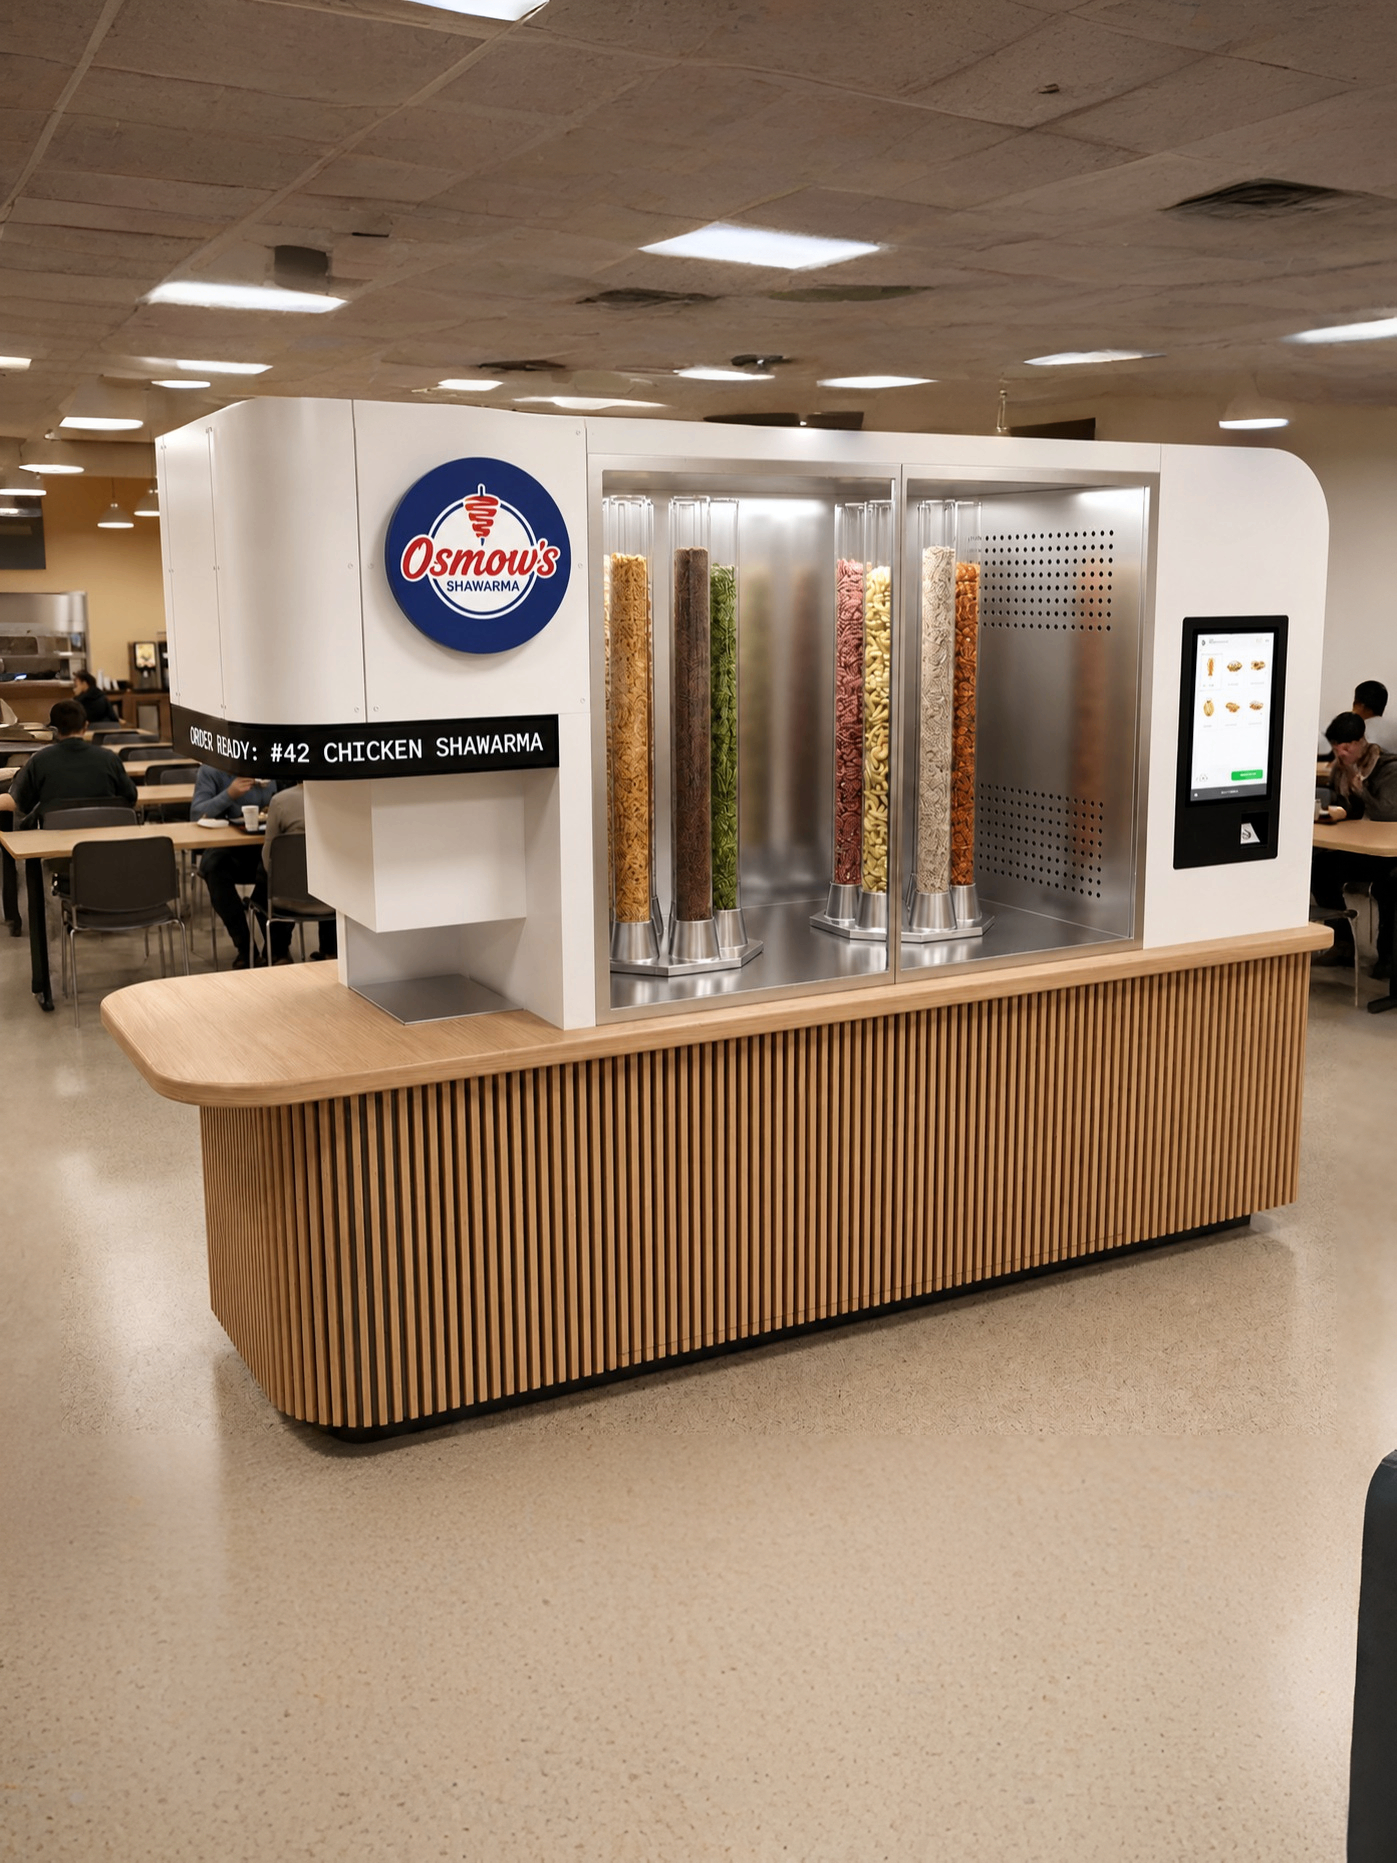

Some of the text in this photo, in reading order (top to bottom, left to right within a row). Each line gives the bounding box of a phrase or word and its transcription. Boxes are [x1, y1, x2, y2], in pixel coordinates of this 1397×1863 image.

[402, 536, 559, 580] Osmow's
[446, 580, 520, 592] SHAWARMA
[189, 725, 544, 764] ORDER READY: #42 CHICKEN SHAWARMA
